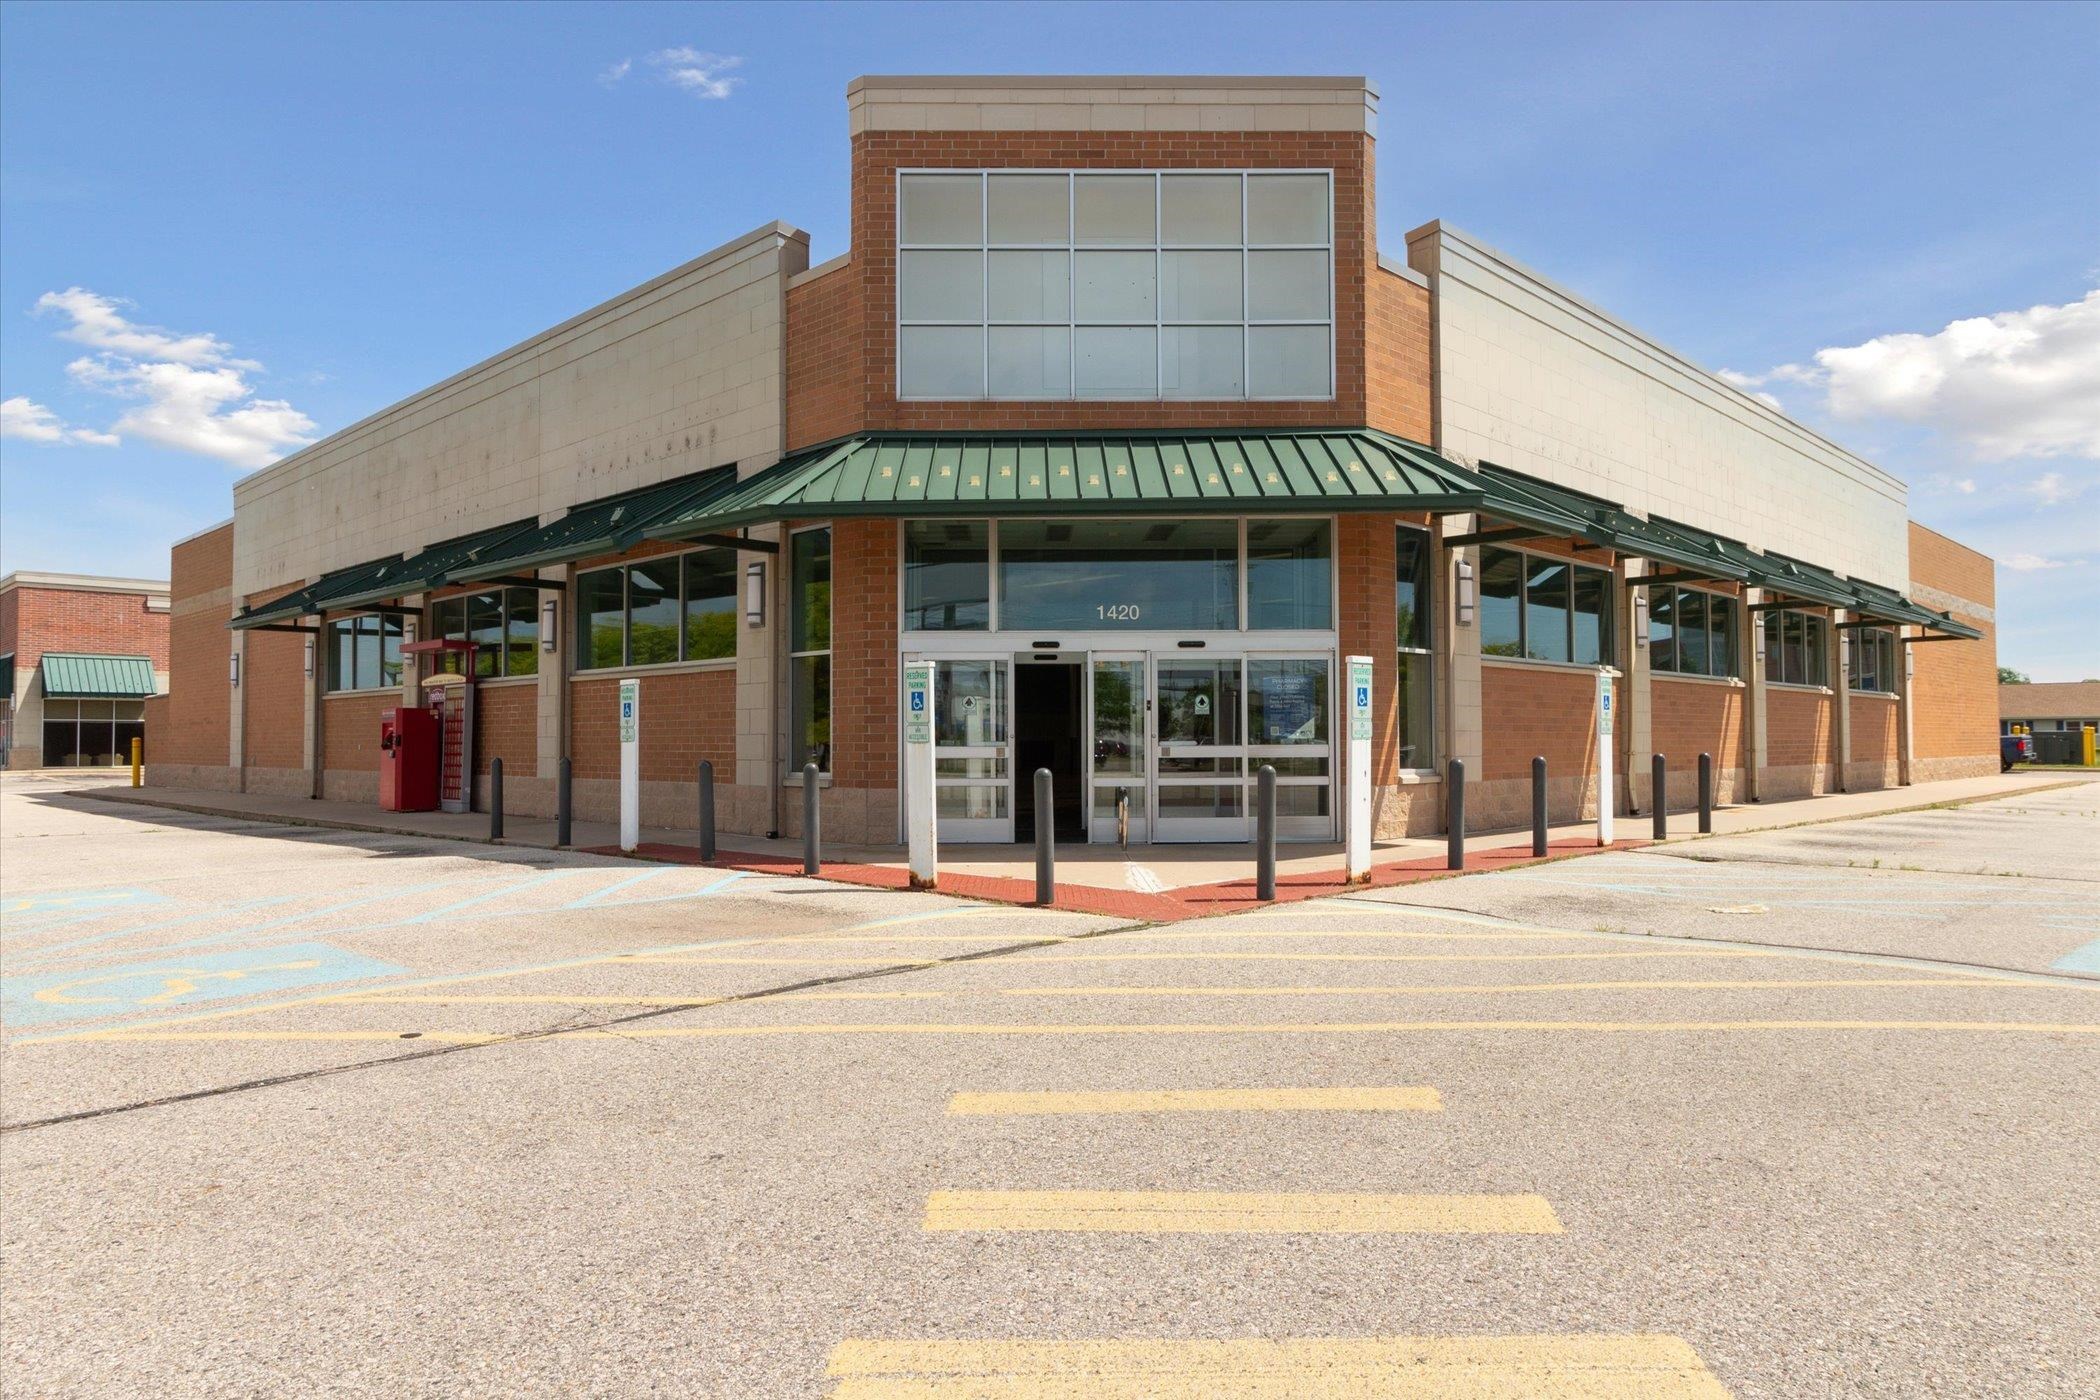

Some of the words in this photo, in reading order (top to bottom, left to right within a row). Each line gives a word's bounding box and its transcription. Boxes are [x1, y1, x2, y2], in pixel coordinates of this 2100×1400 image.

[1097, 605, 1140, 620] 1420
[906, 672, 928, 680] RESERVED
[1272, 677, 1305, 685] PHARMACY
